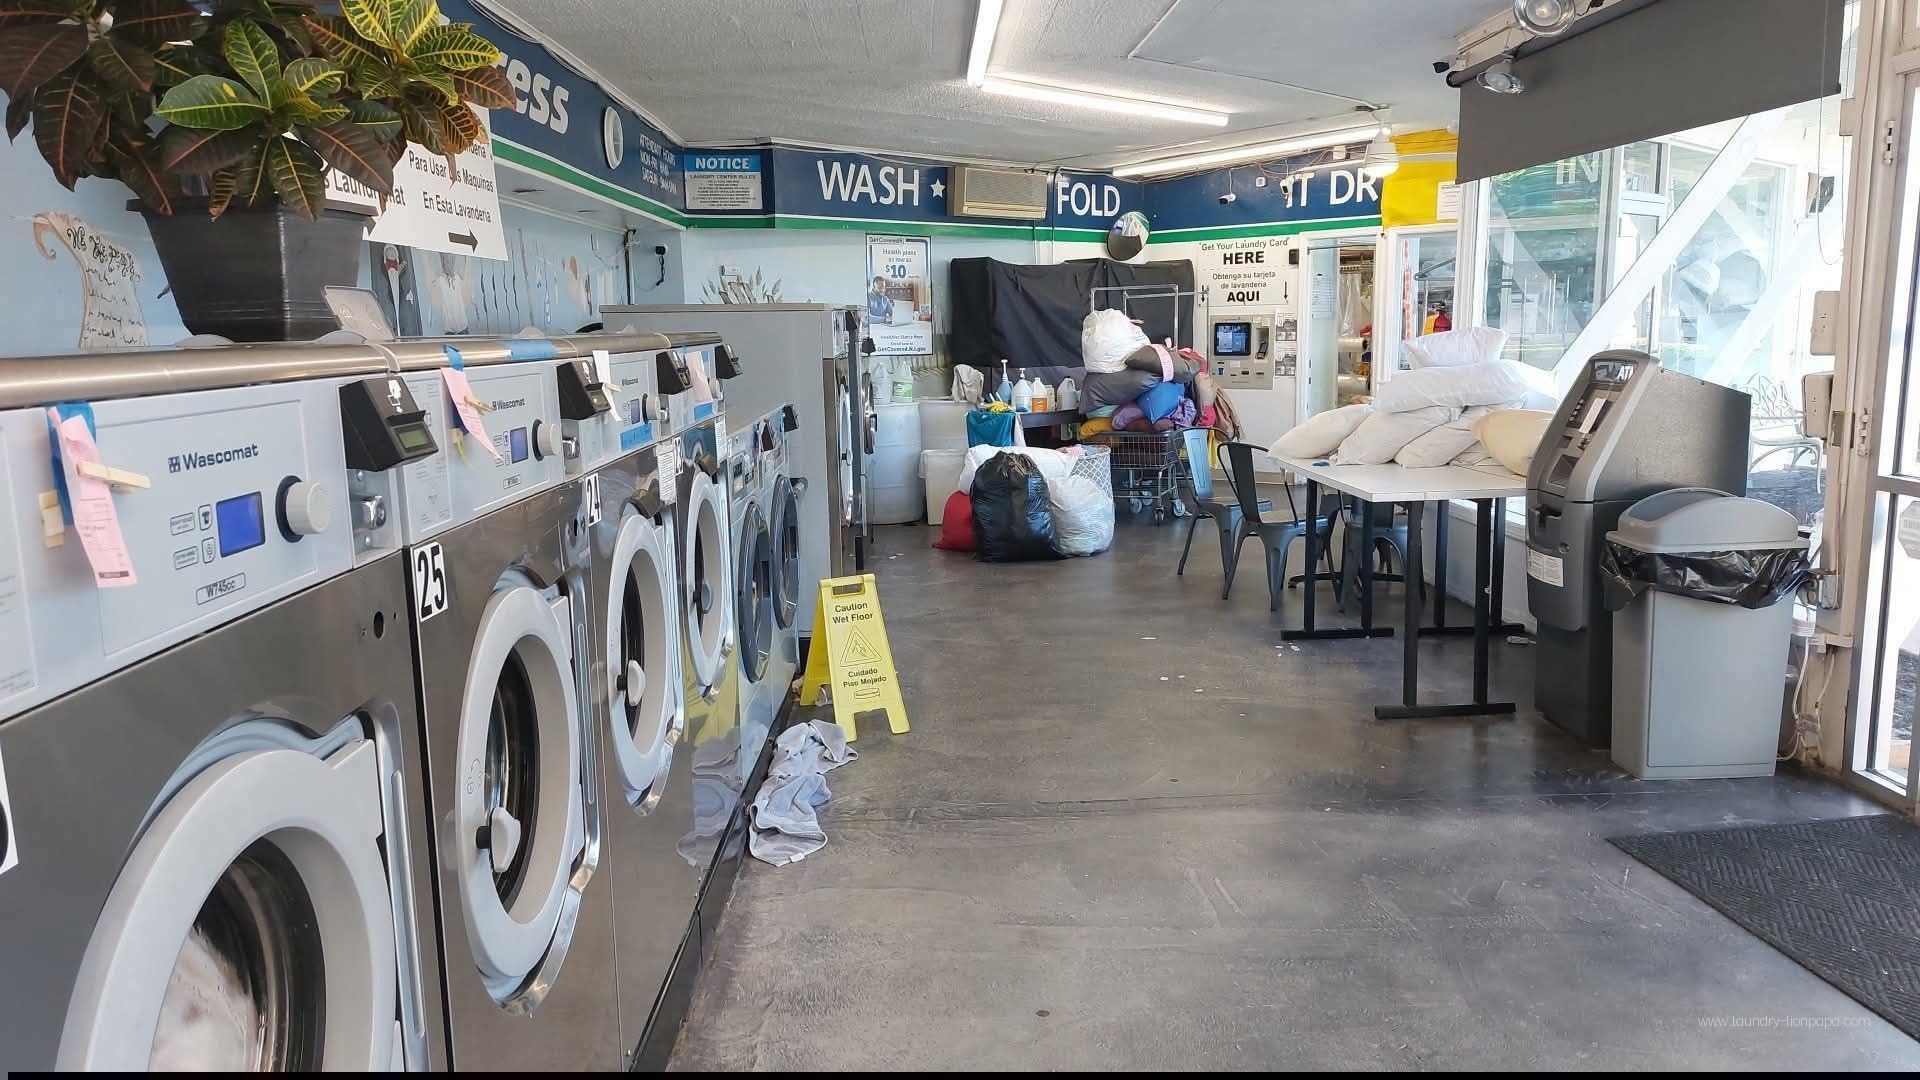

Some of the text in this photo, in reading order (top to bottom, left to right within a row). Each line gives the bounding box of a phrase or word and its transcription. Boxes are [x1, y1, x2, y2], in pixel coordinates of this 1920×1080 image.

[695, 157, 750, 170] NOTICE
[409, 150, 429, 173] Para
[430, 155, 447, 178] Usar
[462, 169, 494, 193] Maquinas
[817, 160, 919, 207] WASH
[1057, 181, 1121, 217] FOLD
[423, 192, 492, 224] En Esta Lavanderia
[1201, 239, 1288, 251] Get Your Laundry Card
[1223, 251, 1265, 265] HERE
[885, 264, 907, 278] $10
[1212, 273, 1242, 281] Obtenga
[1253, 271, 1276, 280] tarjeta
[1231, 281, 1267, 289] lavanderia
[1226, 291, 1260, 305] AQUI
[182, 443, 259, 471] Wascomat
[586, 475, 600, 524] 24
[417, 544, 445, 619] 25
[834, 602, 868, 613] Caution
[832, 611, 873, 624] Wet Floor
[847, 667, 878, 678] Cuidado
[842, 675, 887, 688] Piso Mojado
